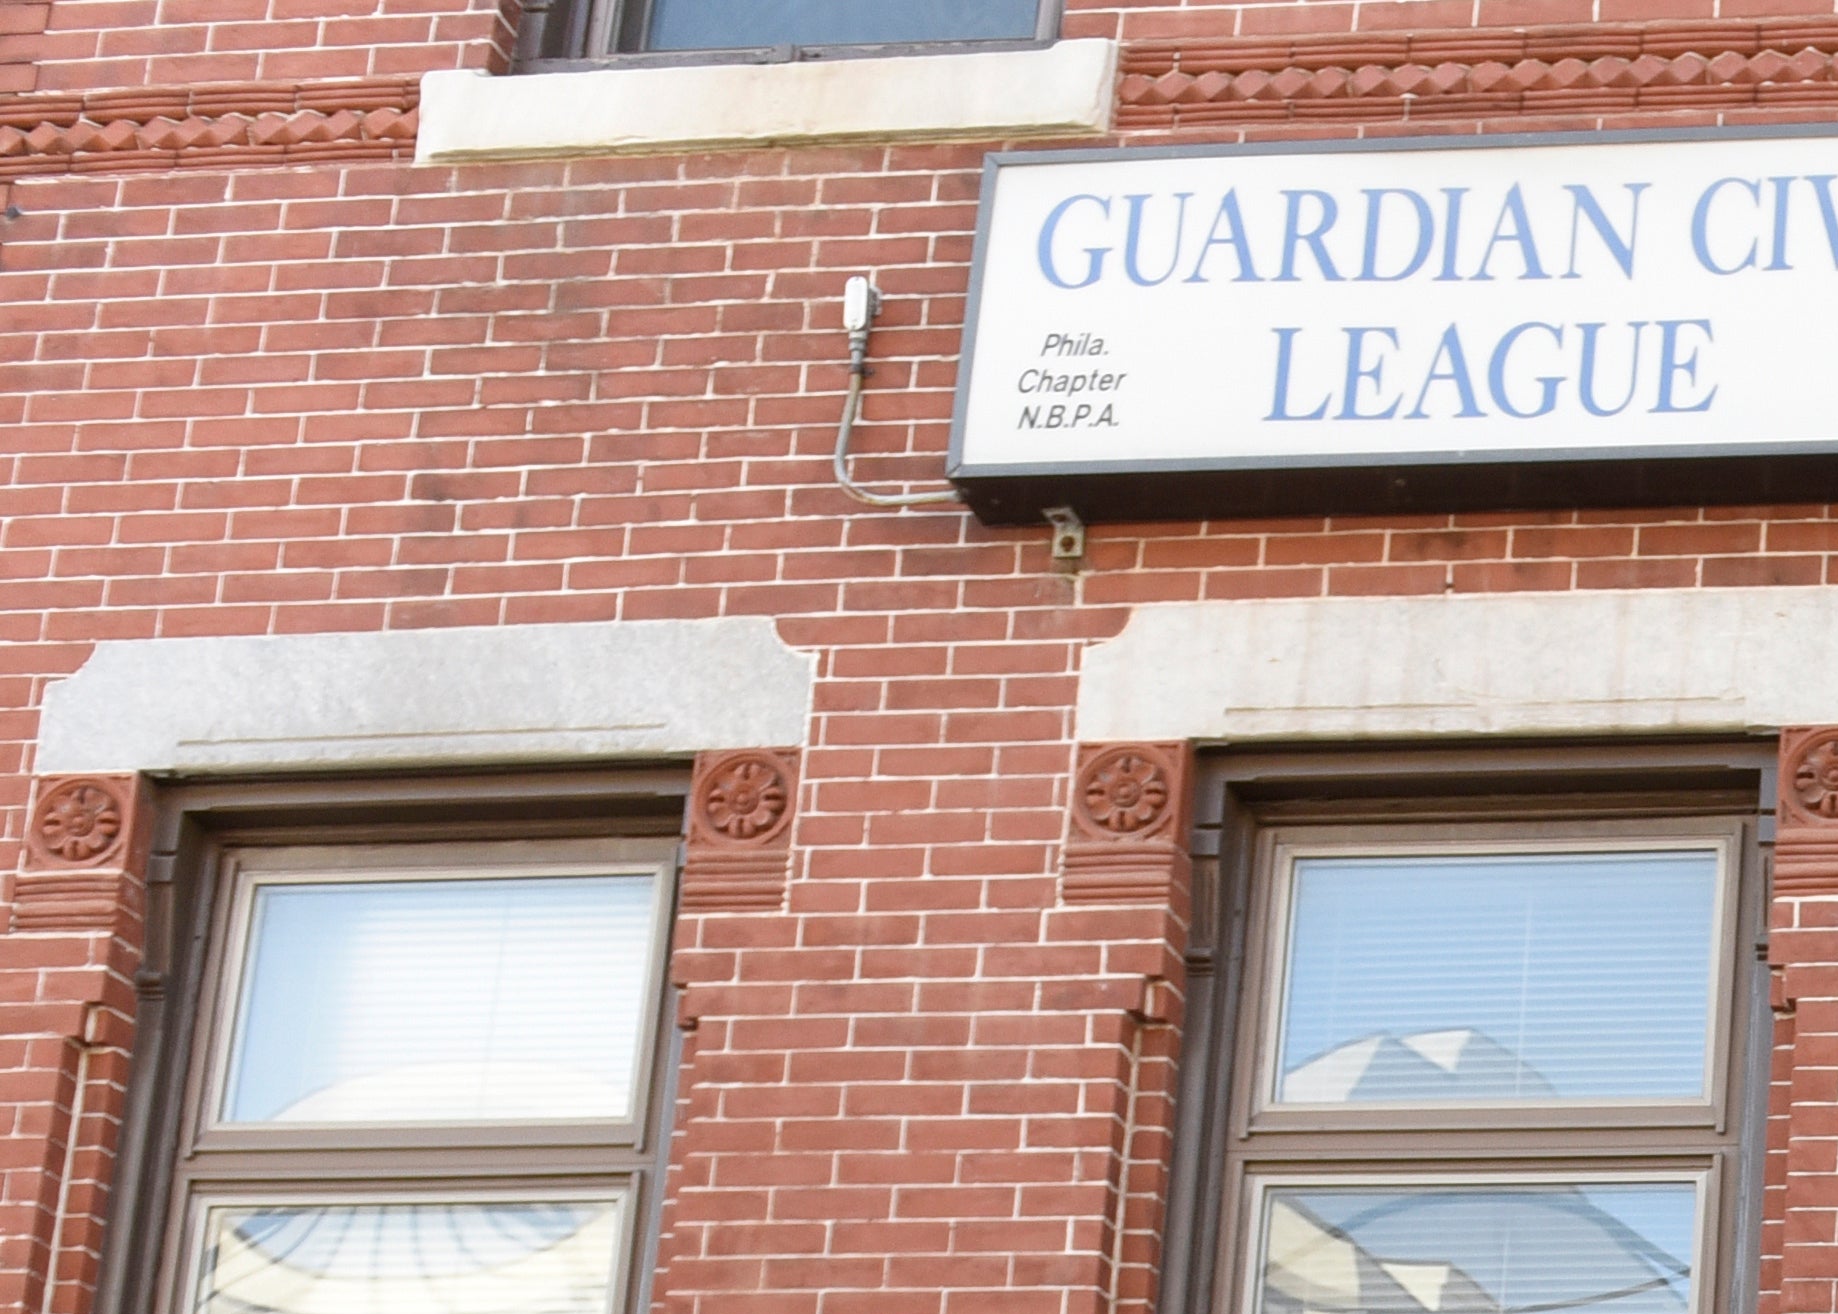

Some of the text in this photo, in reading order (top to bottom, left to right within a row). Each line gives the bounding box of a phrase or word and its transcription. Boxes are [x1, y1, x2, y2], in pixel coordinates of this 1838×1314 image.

[1036, 181, 1654, 290] GUARDIAN
[1040, 332, 1109, 357] Phila.
[1017, 368, 1127, 397] Chapter
[1262, 318, 1719, 422] LEAGUE
[1016, 402, 1119, 430] N.B.P.A.
